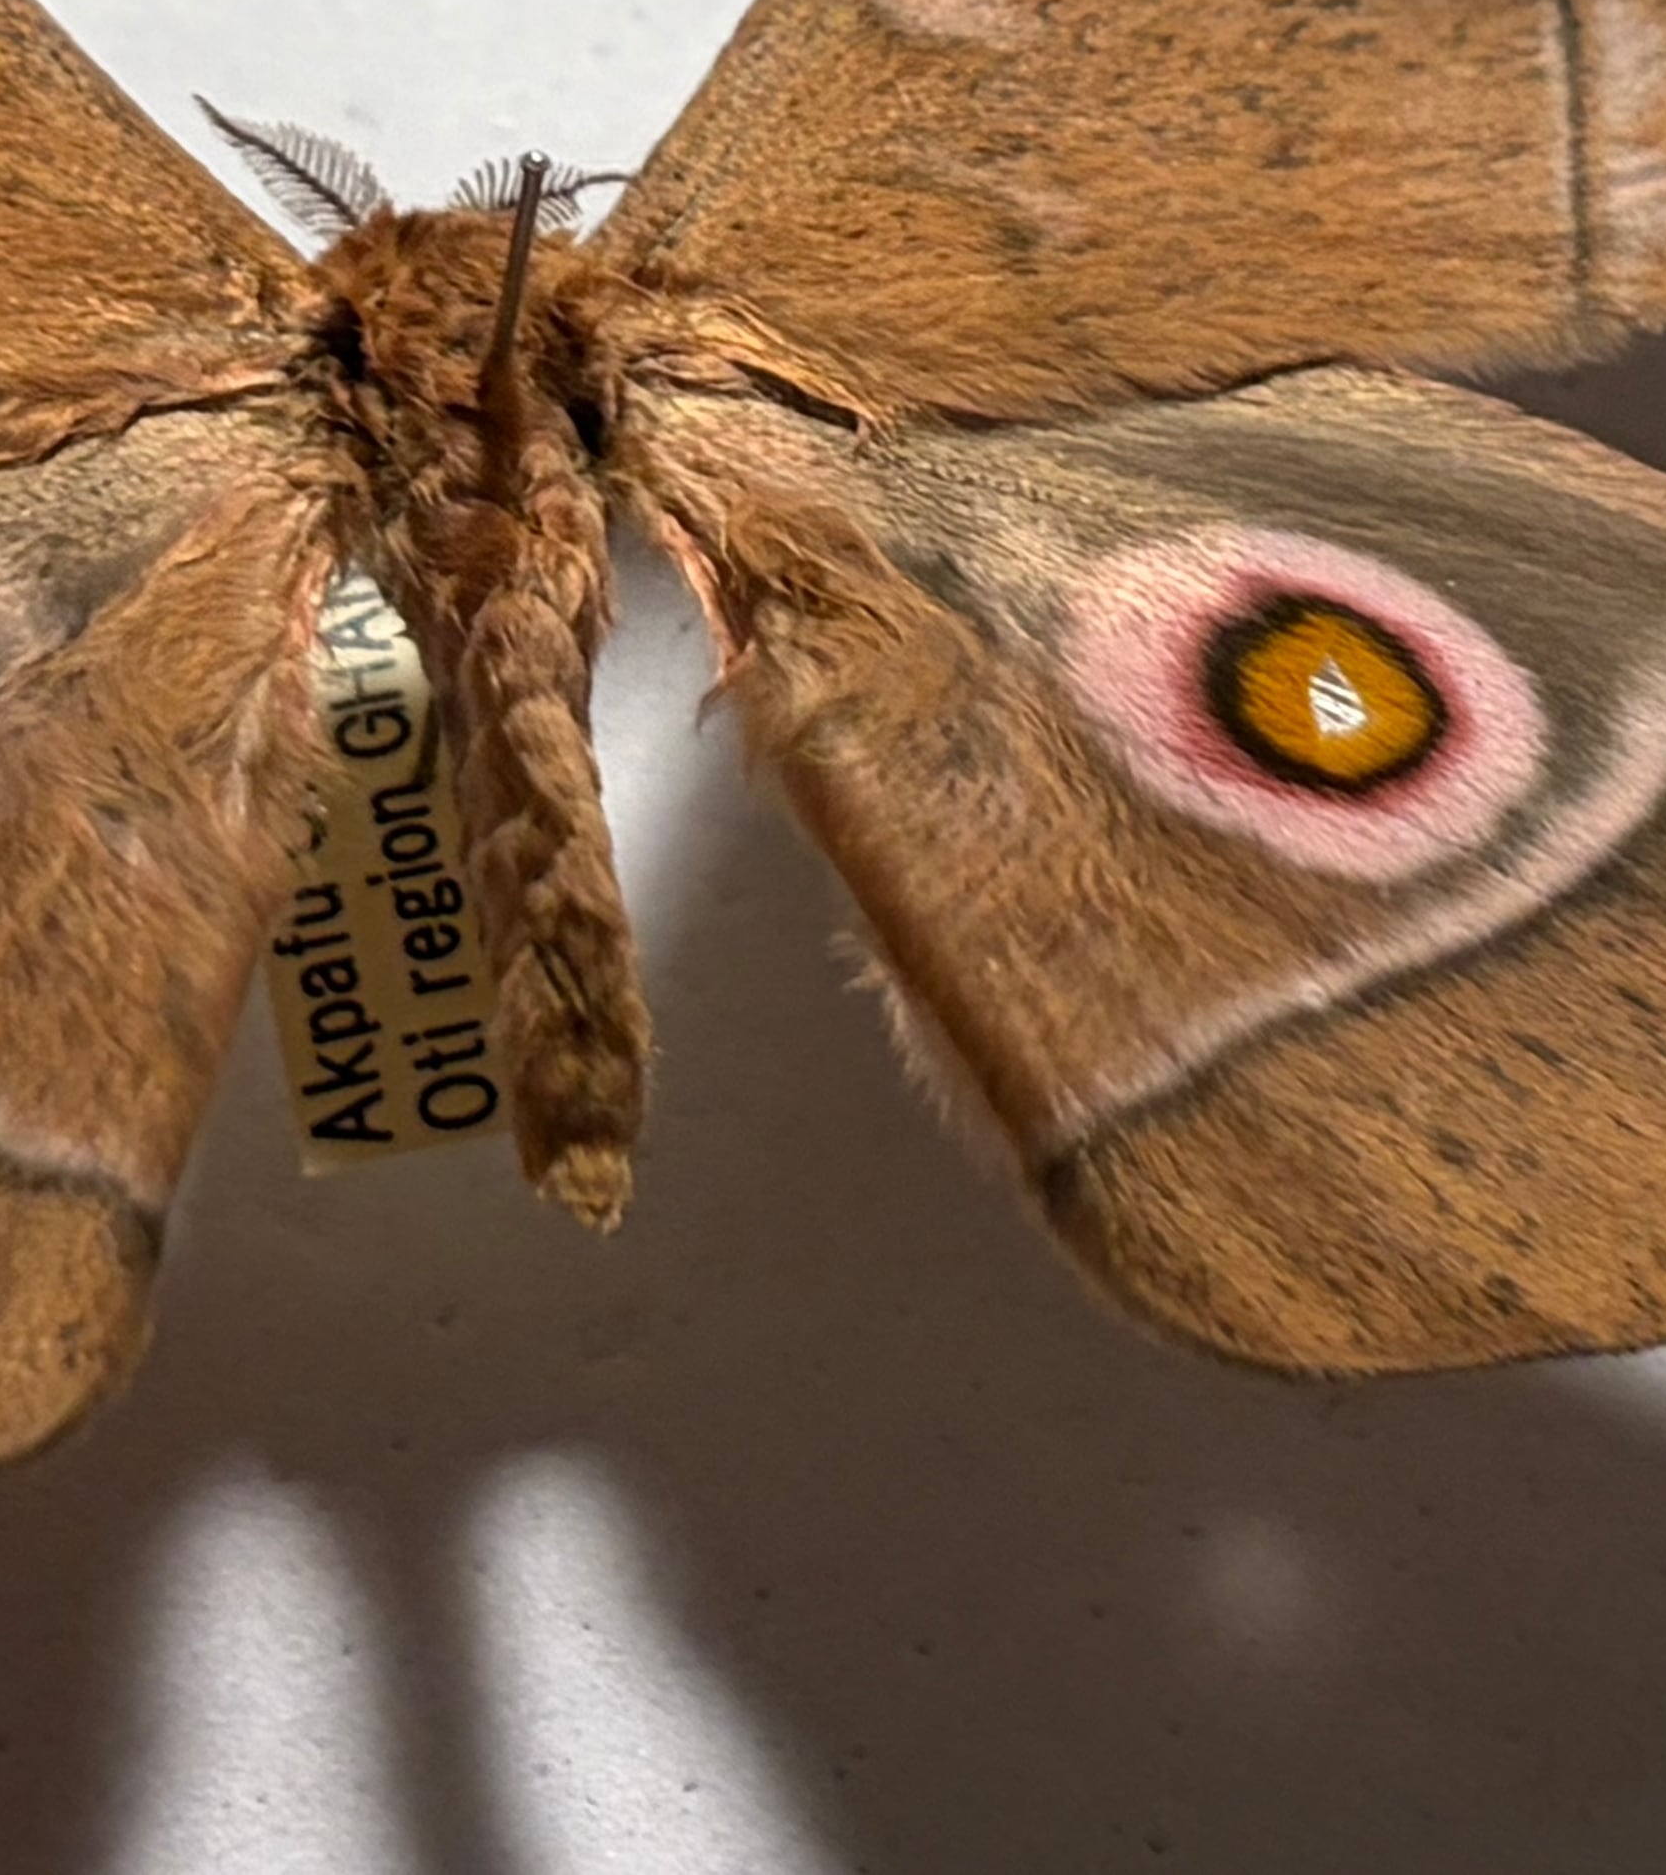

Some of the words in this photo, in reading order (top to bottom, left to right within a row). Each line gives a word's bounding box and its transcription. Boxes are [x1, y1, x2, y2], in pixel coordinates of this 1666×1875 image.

[365, 780, 471, 995] region
[273, 883, 393, 1143] Akpafu
[402, 1021, 499, 1131] Oti
